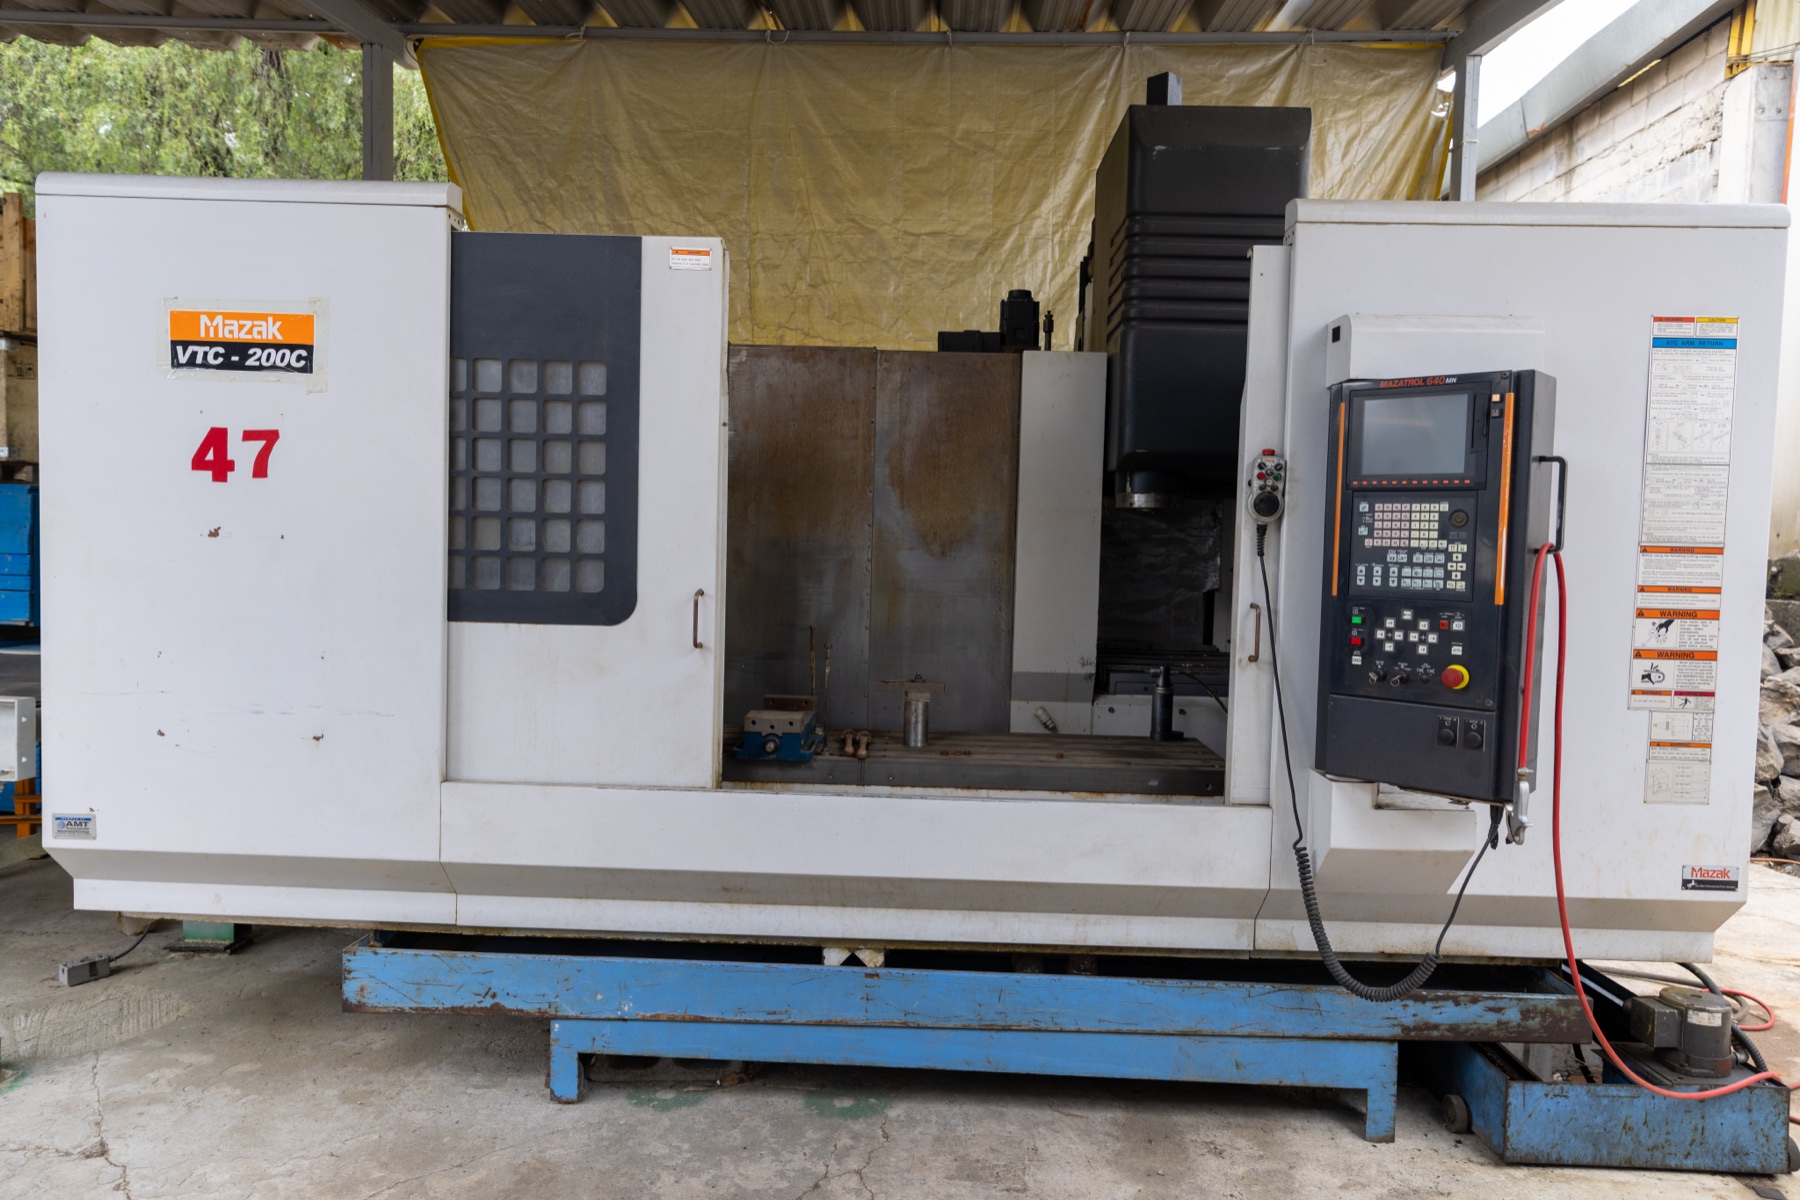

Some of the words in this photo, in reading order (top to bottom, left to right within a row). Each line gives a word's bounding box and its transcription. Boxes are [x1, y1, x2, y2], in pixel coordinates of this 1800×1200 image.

[200, 315, 283, 340] Mazak
[175, 345, 226, 365] VTC
[245, 347, 308, 368] 200C
[1379, 378, 1425, 389] MAZATROL
[191, 426, 280, 483] 47
[1660, 610, 1697, 618] WARNING
[1657, 651, 1695, 659] WARNING
[1690, 866, 1731, 879] Mazak
